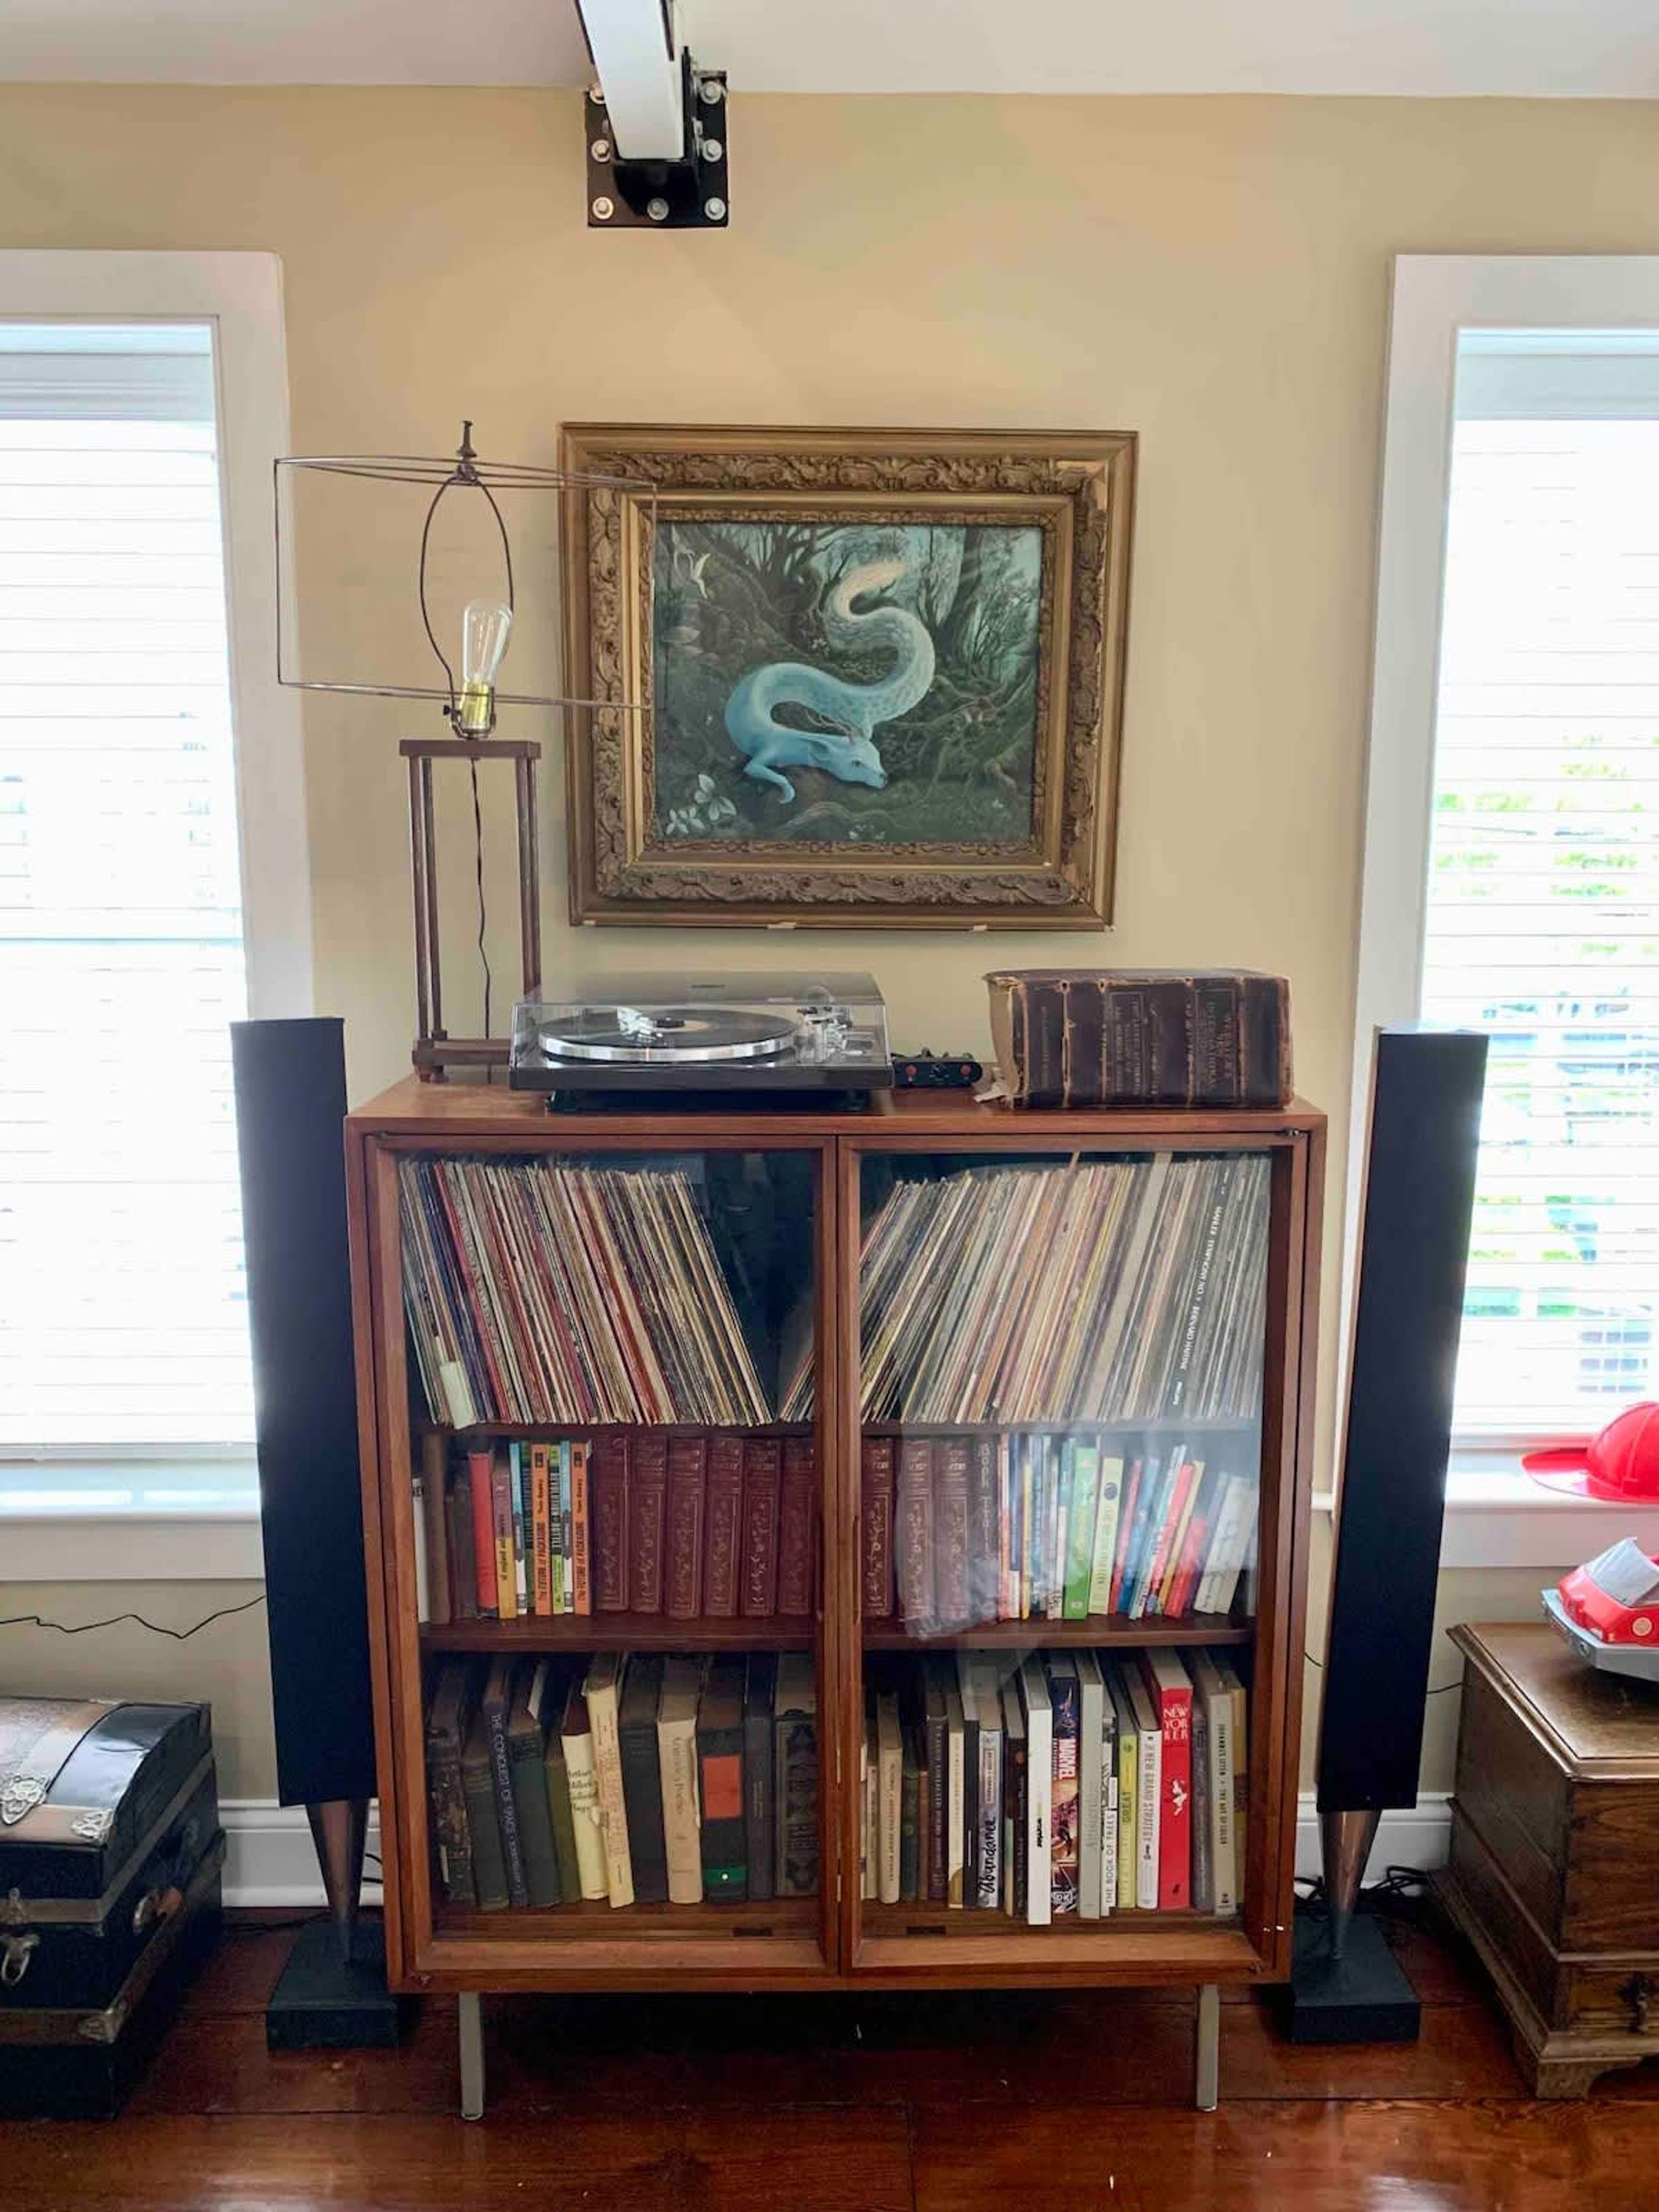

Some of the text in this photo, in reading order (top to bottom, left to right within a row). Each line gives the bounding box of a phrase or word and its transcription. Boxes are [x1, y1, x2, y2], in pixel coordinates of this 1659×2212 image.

[1163, 1708, 1188, 1719] NEW
[492, 1733, 509, 1784] CONQUEST
[1060, 1738, 1076, 1778] MARVEL
[1144, 1753, 1154, 1770] NEW
[1122, 1791, 1130, 1823] GREAT
[1143, 1802, 1152, 1841] STRATEGY
[979, 1818, 995, 1893] Abundance
[1106, 1843, 1113, 1855] OF
